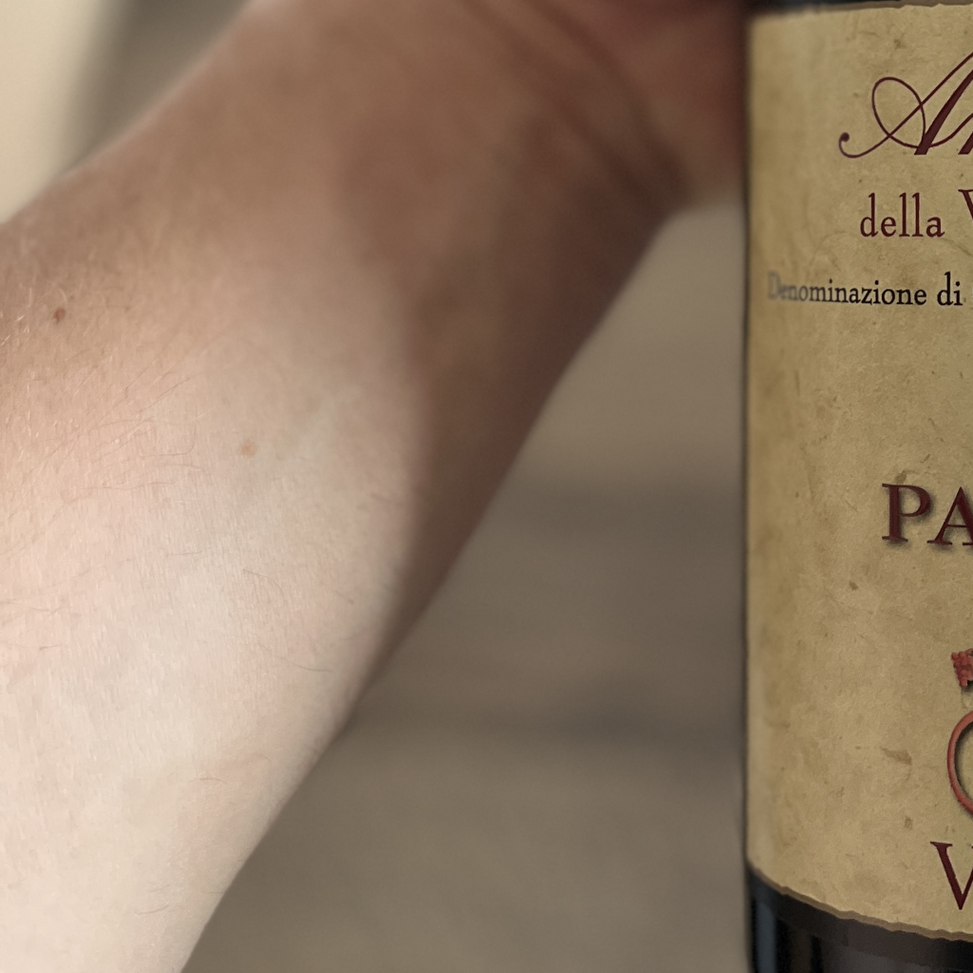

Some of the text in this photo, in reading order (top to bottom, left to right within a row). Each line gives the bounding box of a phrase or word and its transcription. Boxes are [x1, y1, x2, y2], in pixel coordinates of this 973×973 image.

[859, 193, 946, 238] della
[767, 270, 928, 307] Denominazione
[936, 271, 963, 307] di
